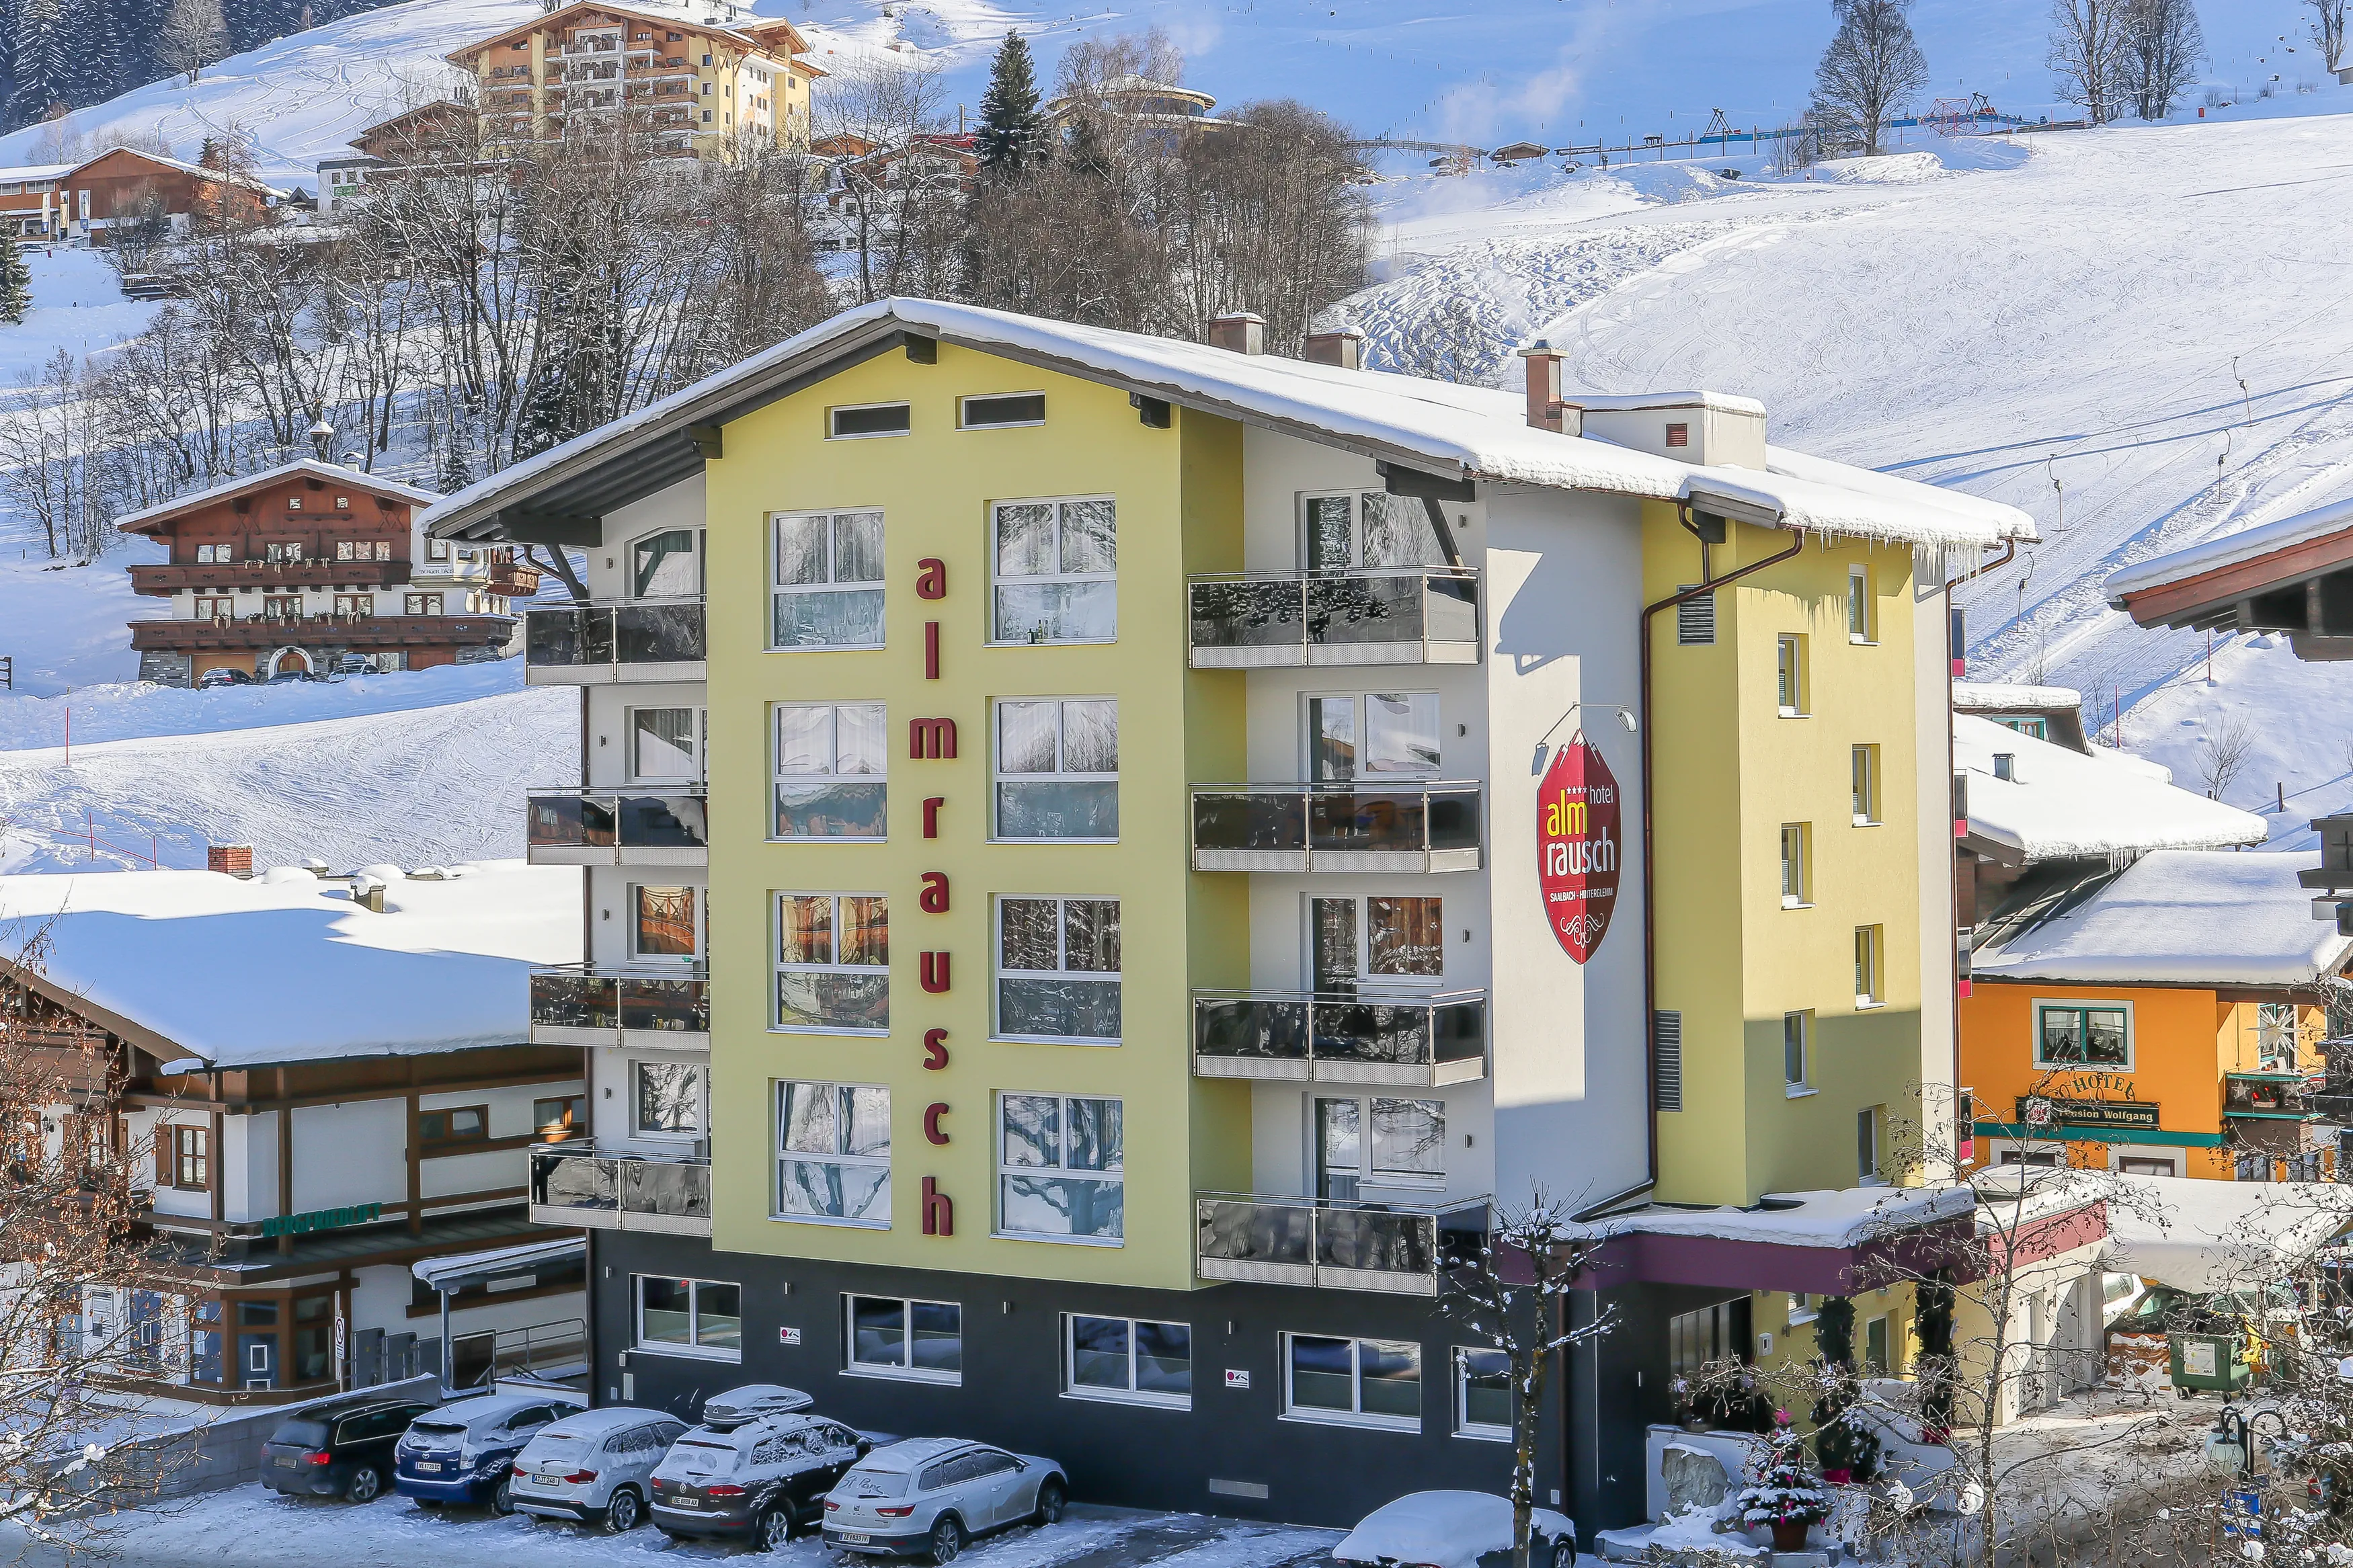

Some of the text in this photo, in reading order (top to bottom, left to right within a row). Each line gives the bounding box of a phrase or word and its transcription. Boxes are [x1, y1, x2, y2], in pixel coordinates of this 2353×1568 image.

[1589, 784, 1613, 804] hotel
[1546, 789, 1587, 837] alm
[1547, 826, 1615, 876] rausch
[1550, 891, 1577, 903] SAALBACH
[1579, 887, 1613, 900] HINTERGLEMM
[2073, 1074, 2135, 1098] HOTEL
[2104, 1110, 2153, 1123] Wolfgang
